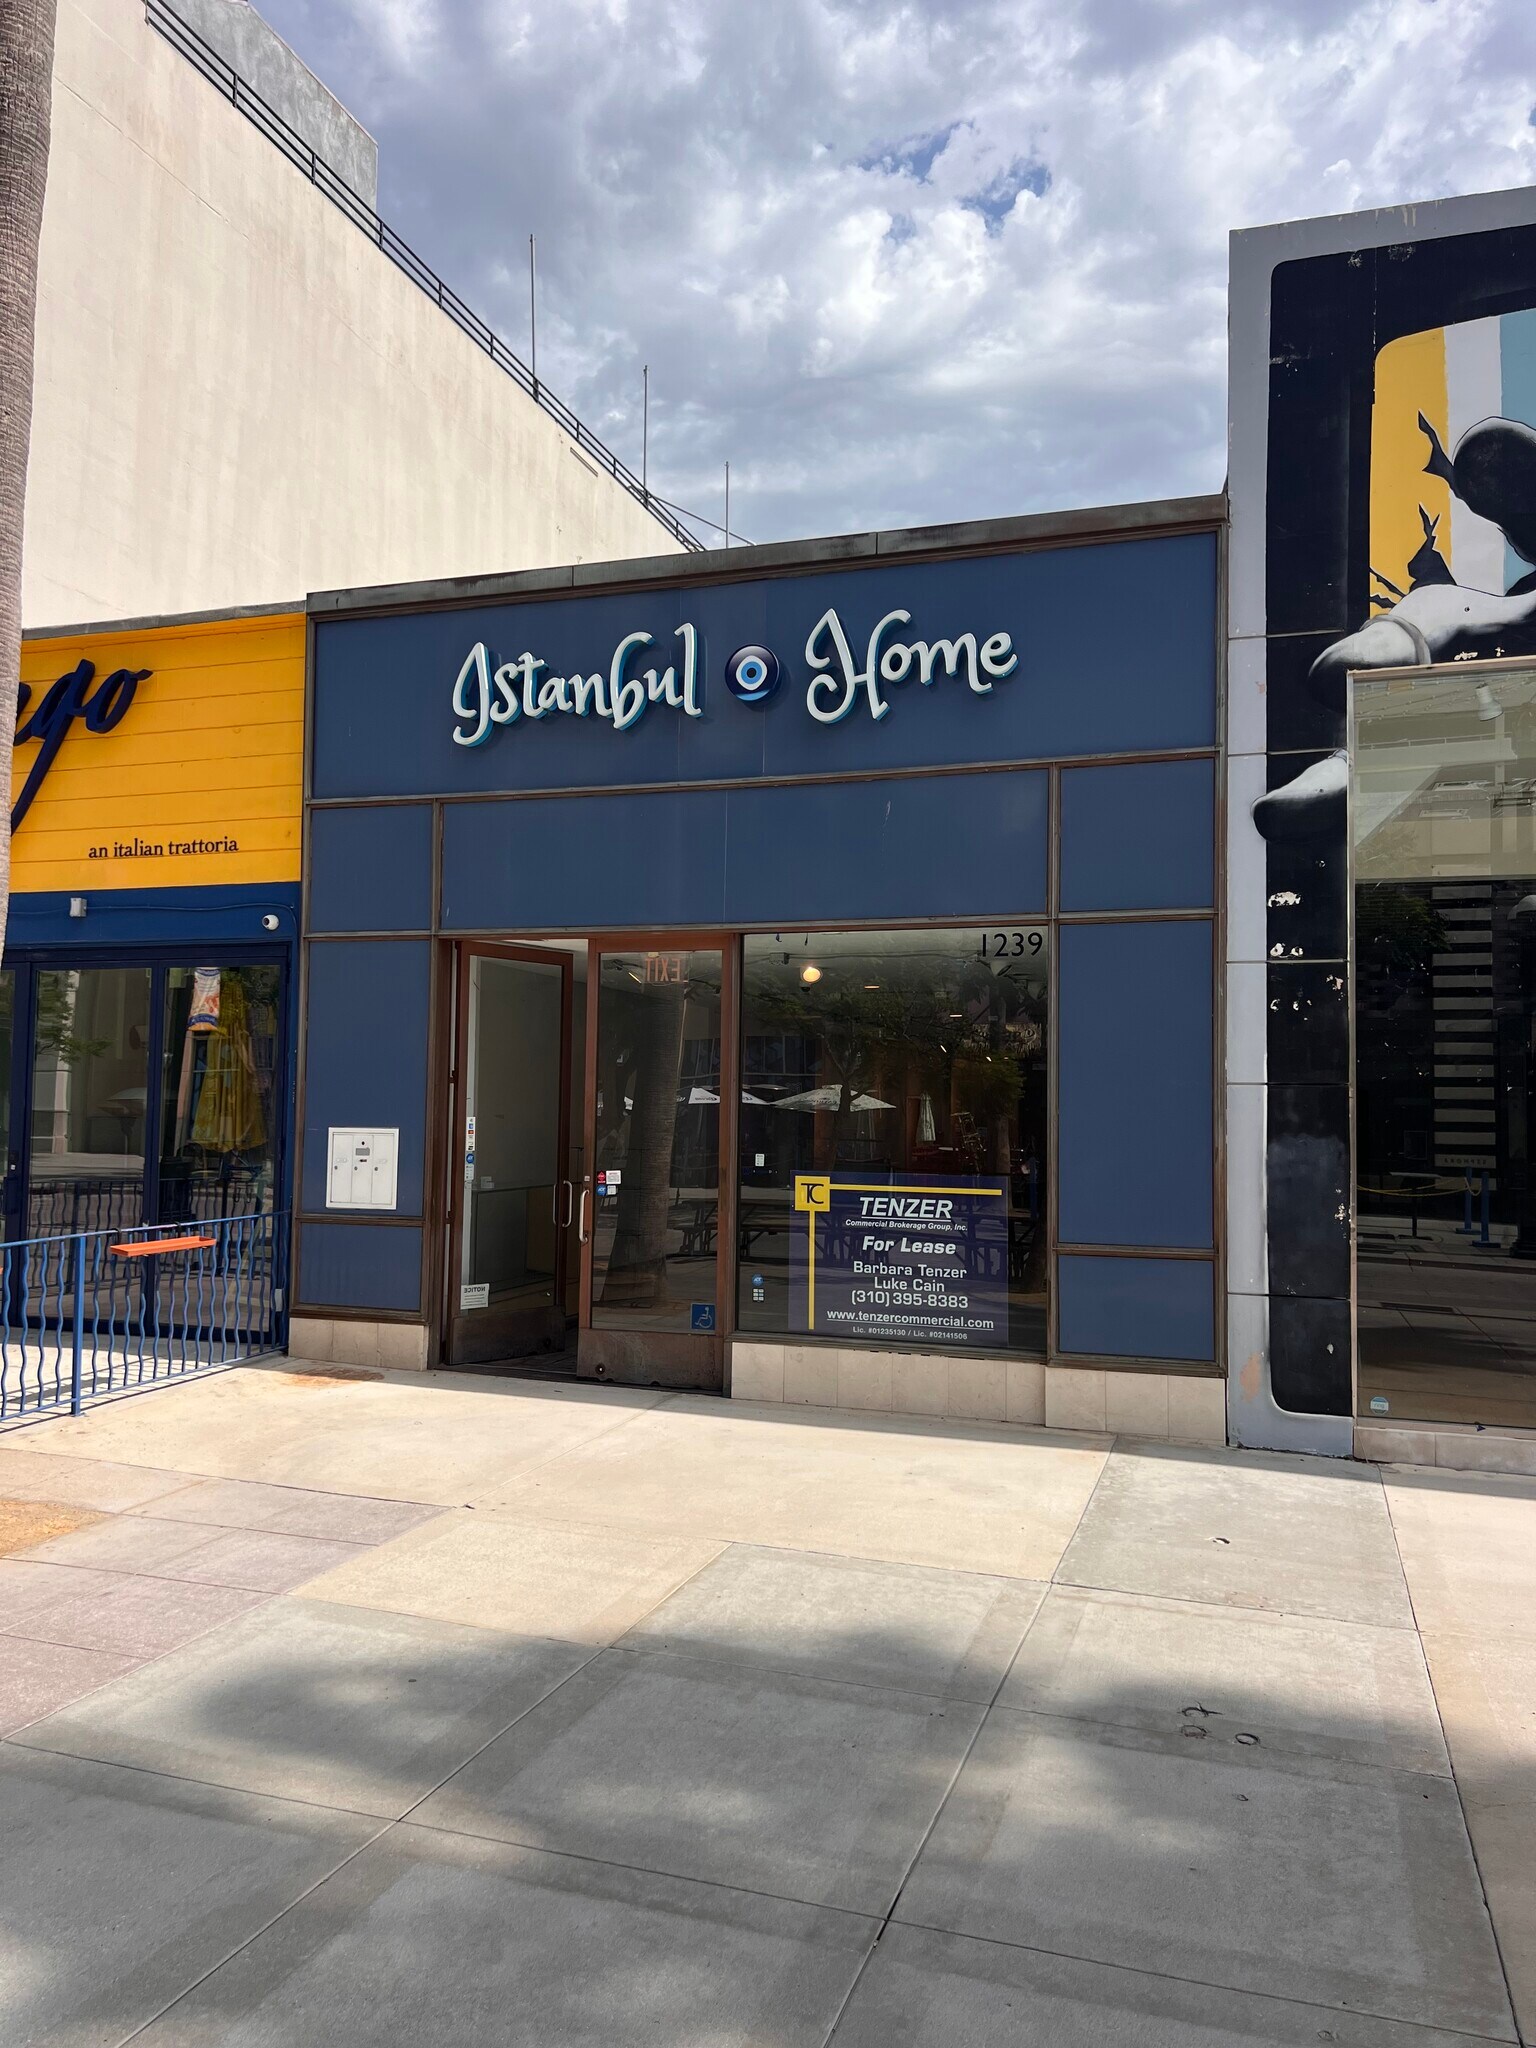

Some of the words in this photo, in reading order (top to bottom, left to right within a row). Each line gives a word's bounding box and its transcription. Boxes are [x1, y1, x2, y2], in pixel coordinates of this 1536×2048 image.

[452, 622, 703, 747] Istanbul
[806, 608, 1018, 724] Home
[88, 846, 108, 858] an
[113, 838, 163, 857] italian
[168, 836, 239, 855] trattoria
[982, 932, 1043, 957] 1239
[801, 1183, 824, 1204] TC
[859, 1196, 953, 1219] TENZER
[845, 1219, 888, 1228] Commercial
[889, 1220, 926, 1231] Brokerage
[928, 1223, 953, 1232] Group,
[862, 1235, 895, 1252] For
[900, 1237, 957, 1255] Lease
[853, 1260, 913, 1276] Barbara
[918, 1263, 967, 1279] Tenzer
[874, 1276, 908, 1290] Luke
[912, 1278, 945, 1292] Cain
[851, 1290, 890, 1307] (310)
[892, 1292, 969, 1309] 395-8383
[826, 1310, 994, 1329] www.tenzercommercial.com
[852, 1326, 866, 1334] Lic.
[913, 1330, 927, 1338] Lic.
